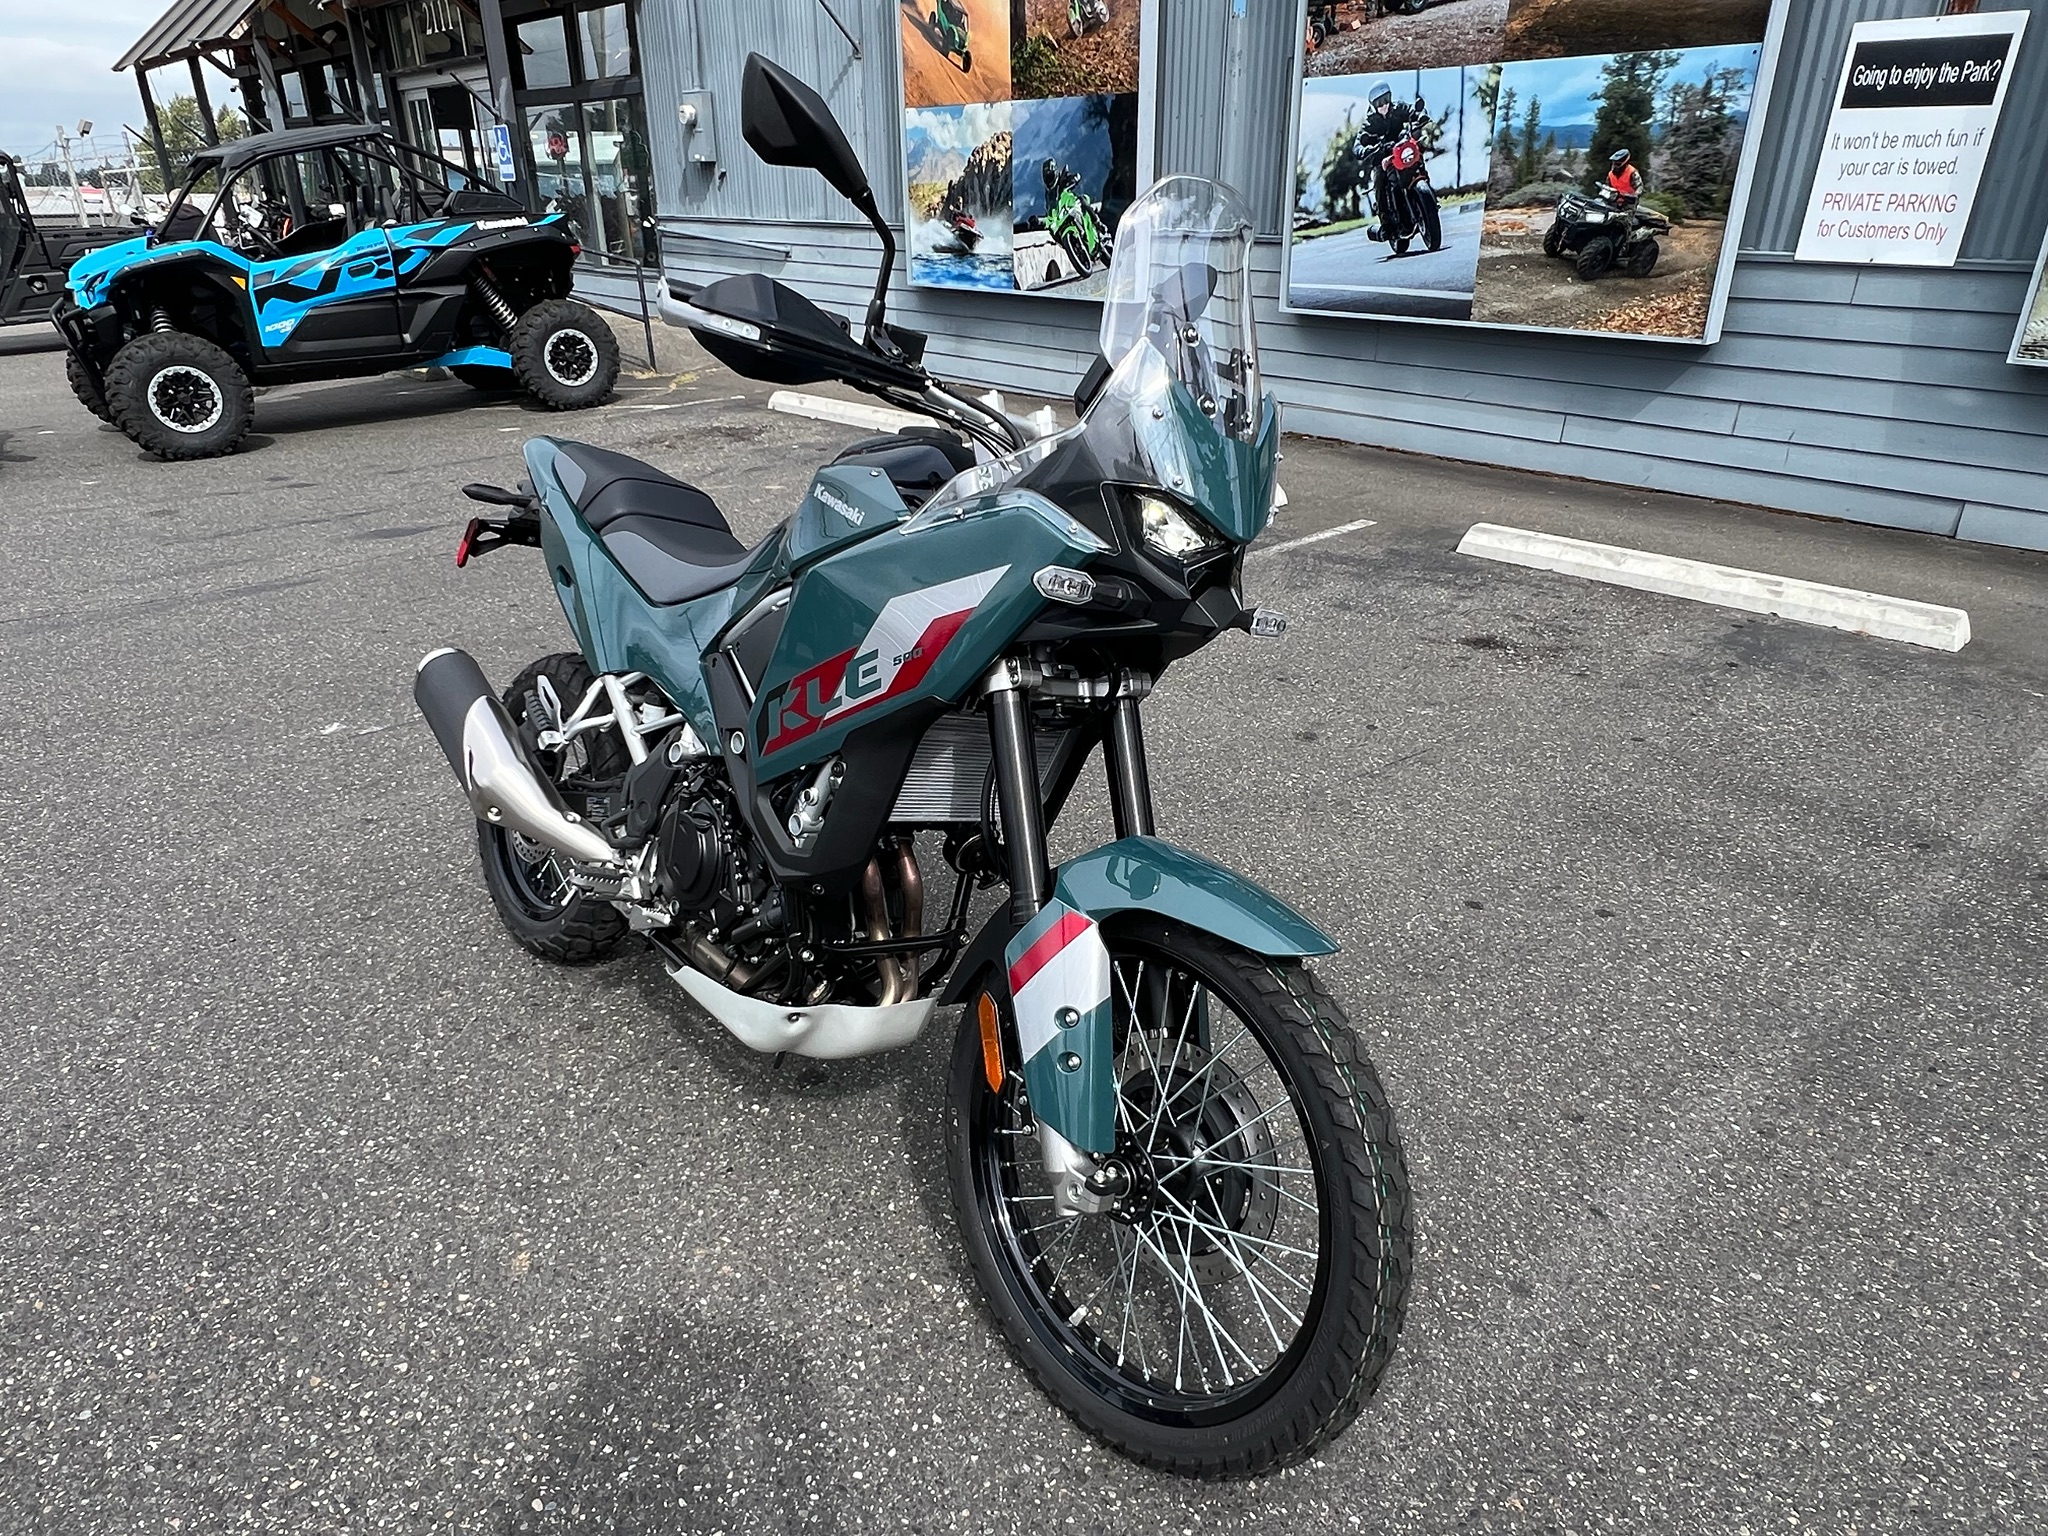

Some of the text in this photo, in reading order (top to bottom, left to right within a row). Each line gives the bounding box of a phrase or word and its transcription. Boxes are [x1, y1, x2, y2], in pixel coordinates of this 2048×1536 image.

[421, 0, 454, 35] 2111
[1852, 58, 2002, 91] Going to enjoy the Park?
[1830, 127, 1986, 150] It won't be much fun if
[1837, 156, 1959, 181] your car is towed.
[1821, 192, 1958, 214] PRIVATE PARKING
[1816, 219, 1949, 246] for Customers Only
[813, 482, 866, 526] Kawasaki
[768, 646, 924, 740] KLE 500
